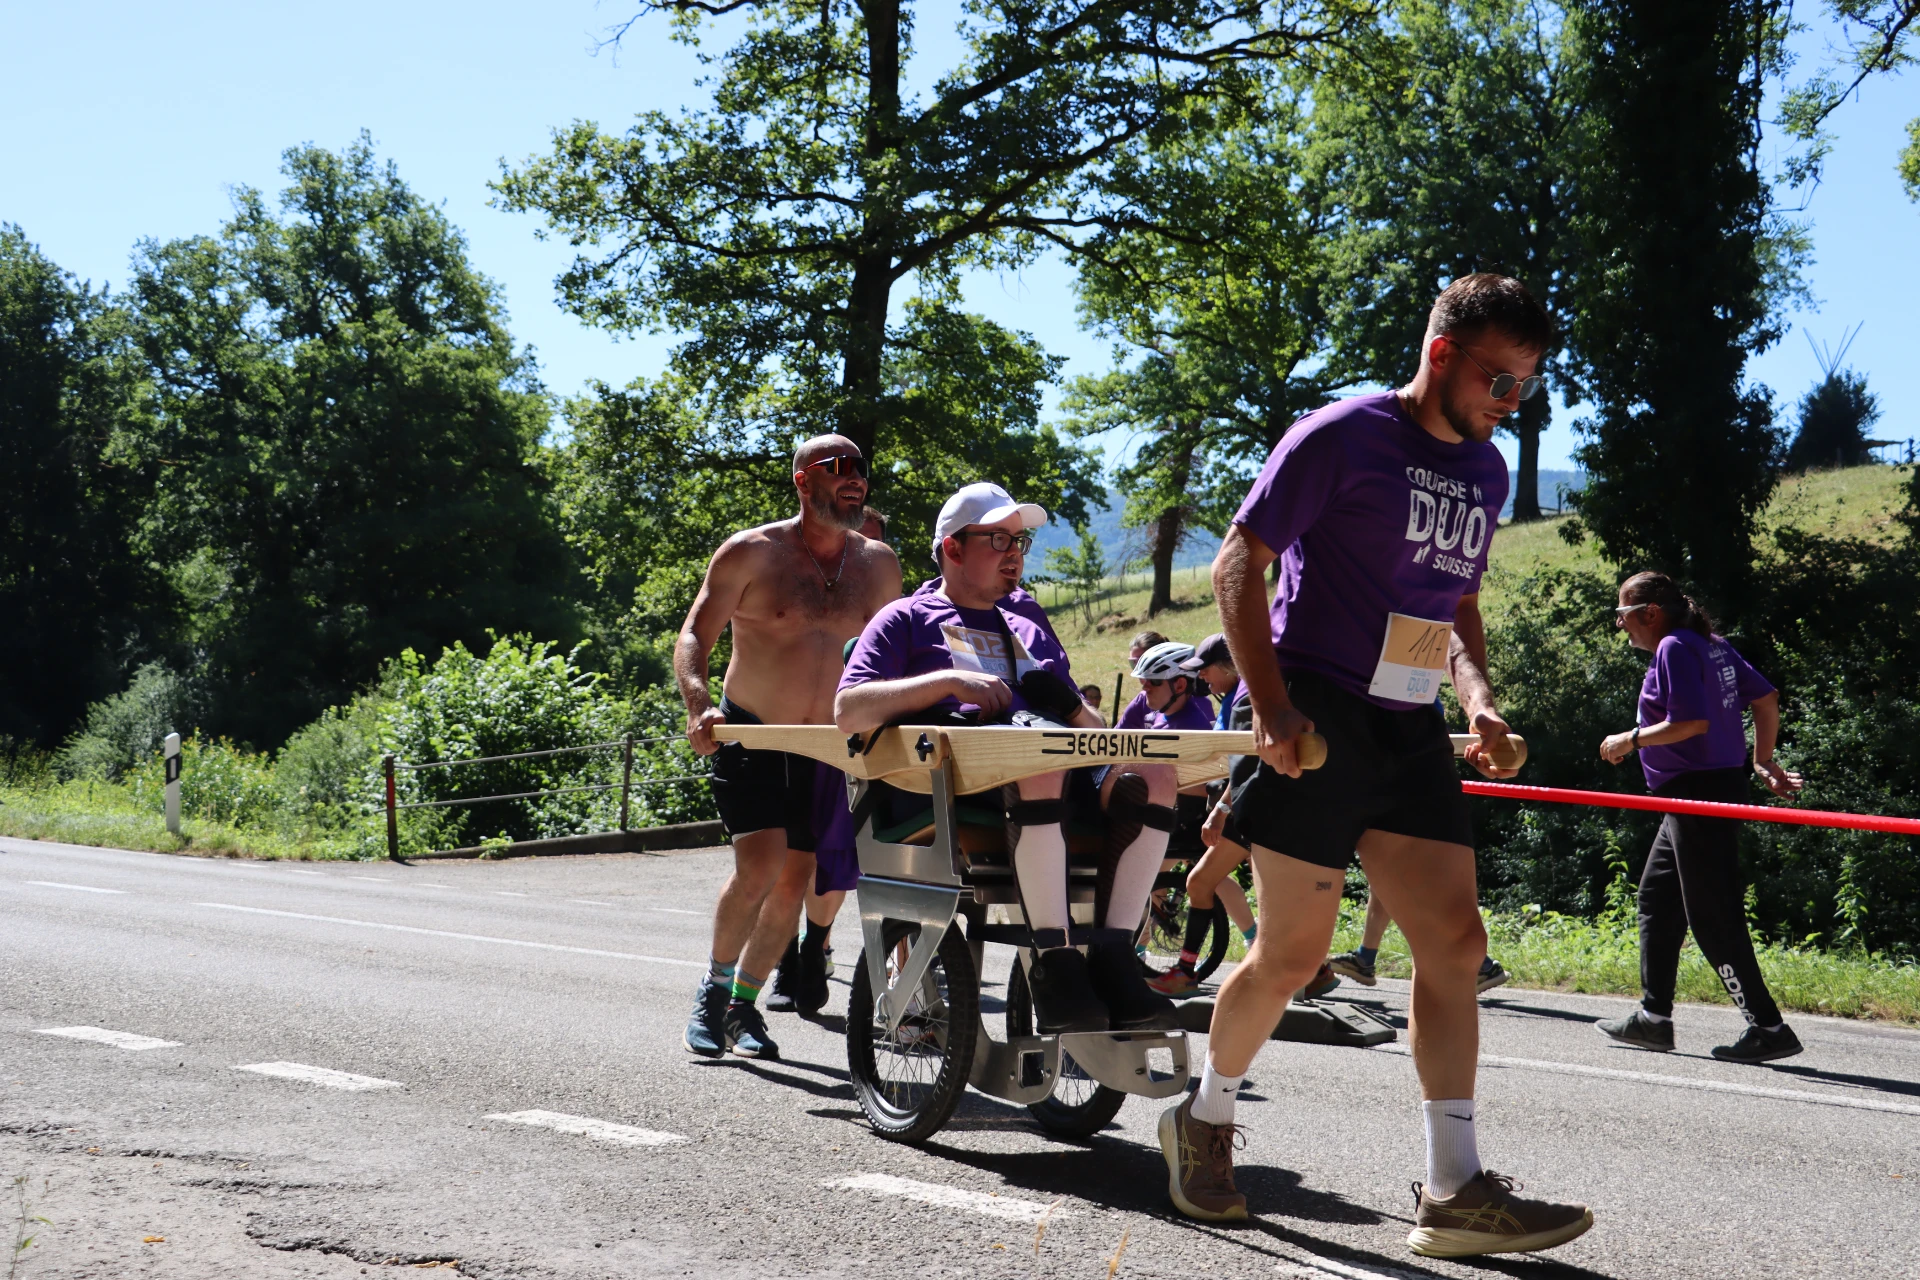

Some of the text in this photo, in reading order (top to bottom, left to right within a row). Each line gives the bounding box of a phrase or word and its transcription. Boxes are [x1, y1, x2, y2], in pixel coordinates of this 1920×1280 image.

[1405, 466, 1467, 500] COURSE
[1404, 489, 1487, 559] DUO
[1432, 553, 1476, 580] SUISSE
[957, 630, 1007, 657] 102
[1407, 676, 1430, 693] DUO
